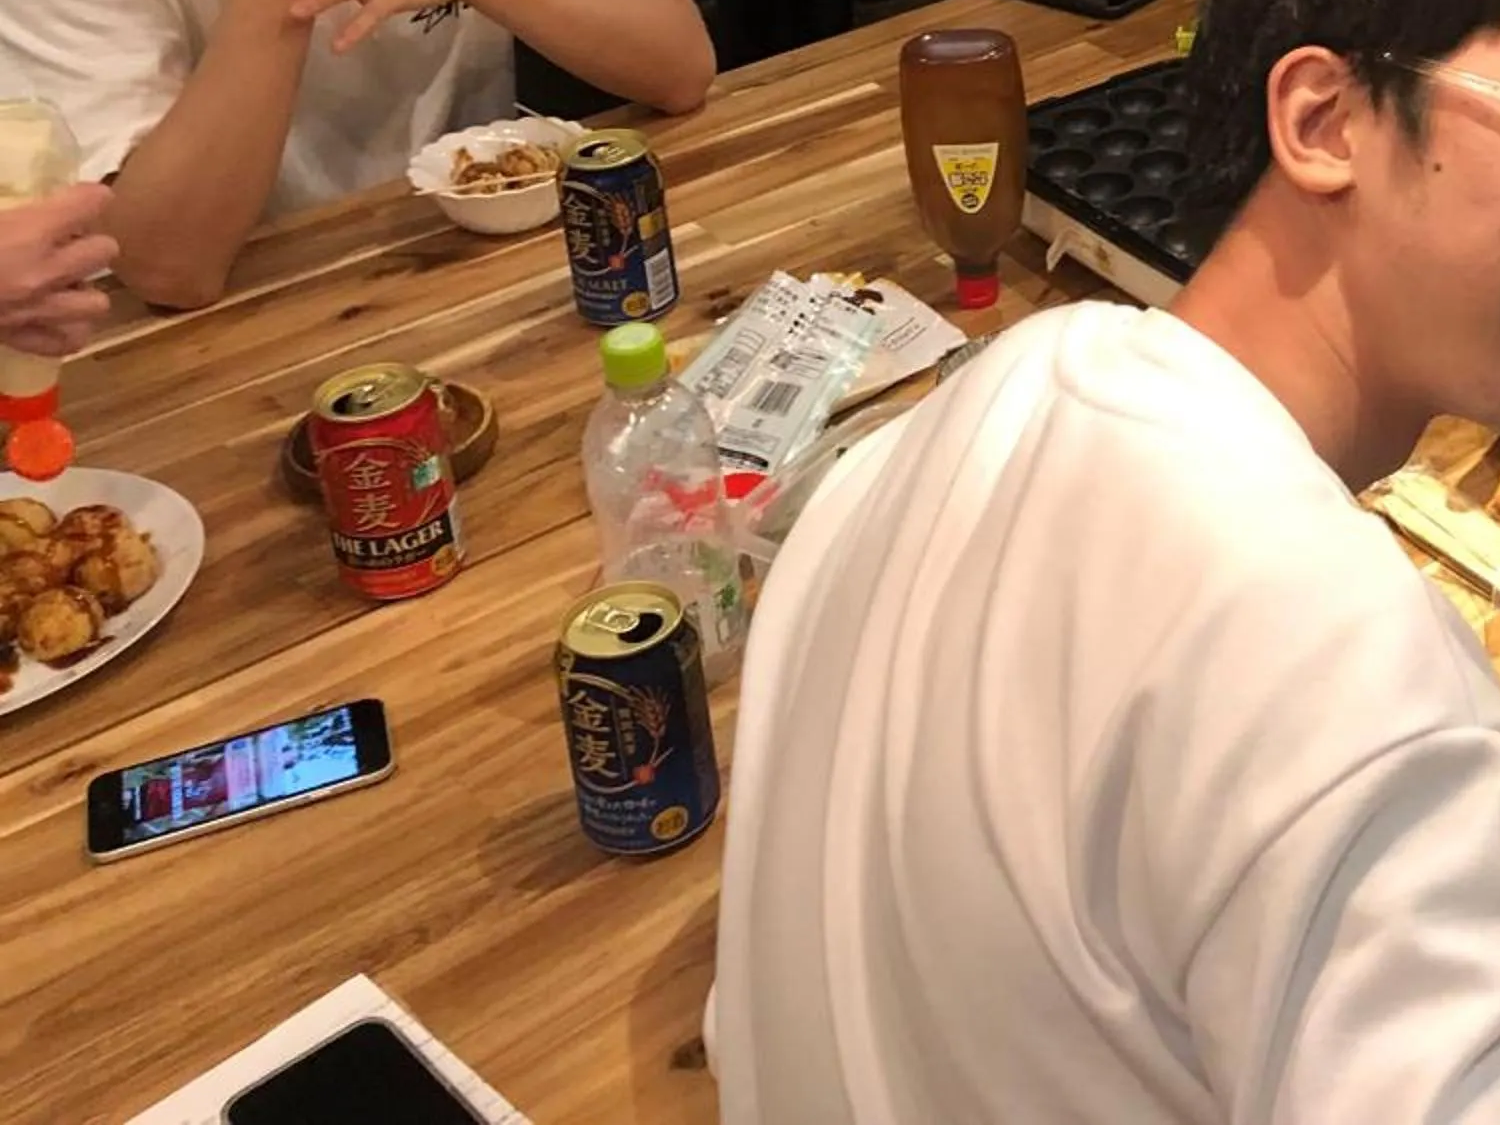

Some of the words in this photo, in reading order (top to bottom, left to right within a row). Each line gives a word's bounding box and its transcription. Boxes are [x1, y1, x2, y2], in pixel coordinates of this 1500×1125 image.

[345, 452, 400, 532] 金麦
[369, 520, 444, 556] LAGER
[567, 690, 622, 779] 金麦
